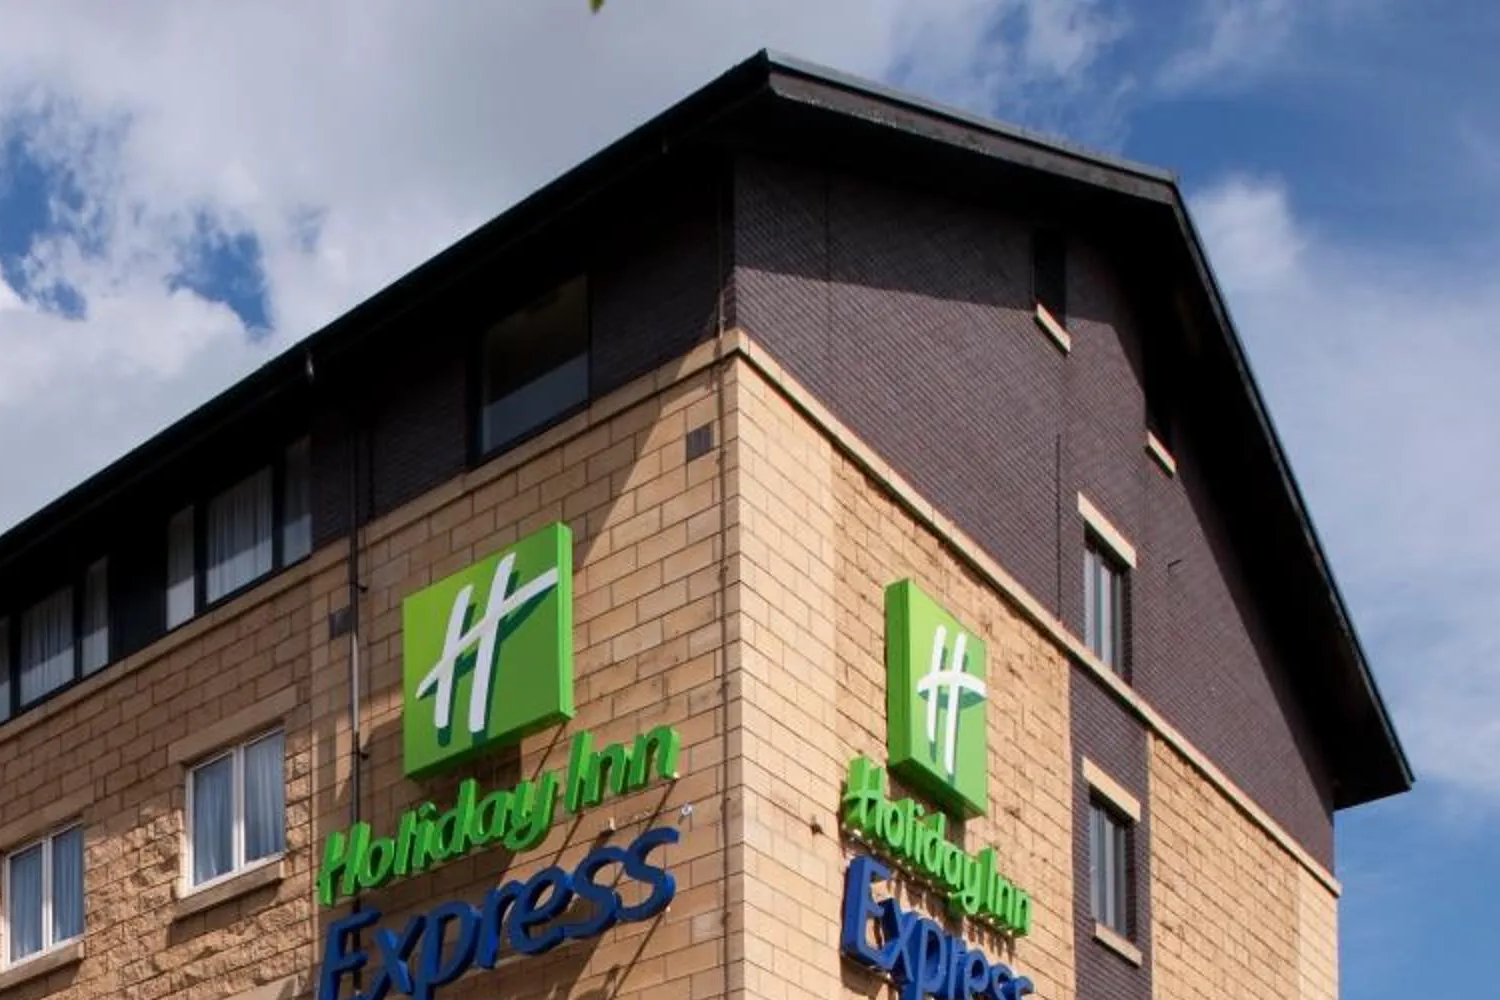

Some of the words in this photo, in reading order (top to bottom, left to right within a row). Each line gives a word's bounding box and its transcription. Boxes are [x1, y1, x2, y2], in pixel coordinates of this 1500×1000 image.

[315, 769, 559, 907] Holiday
[564, 724, 681, 815] Inn
[842, 754, 983, 916] Holiday
[980, 846, 1033, 938] Inn
